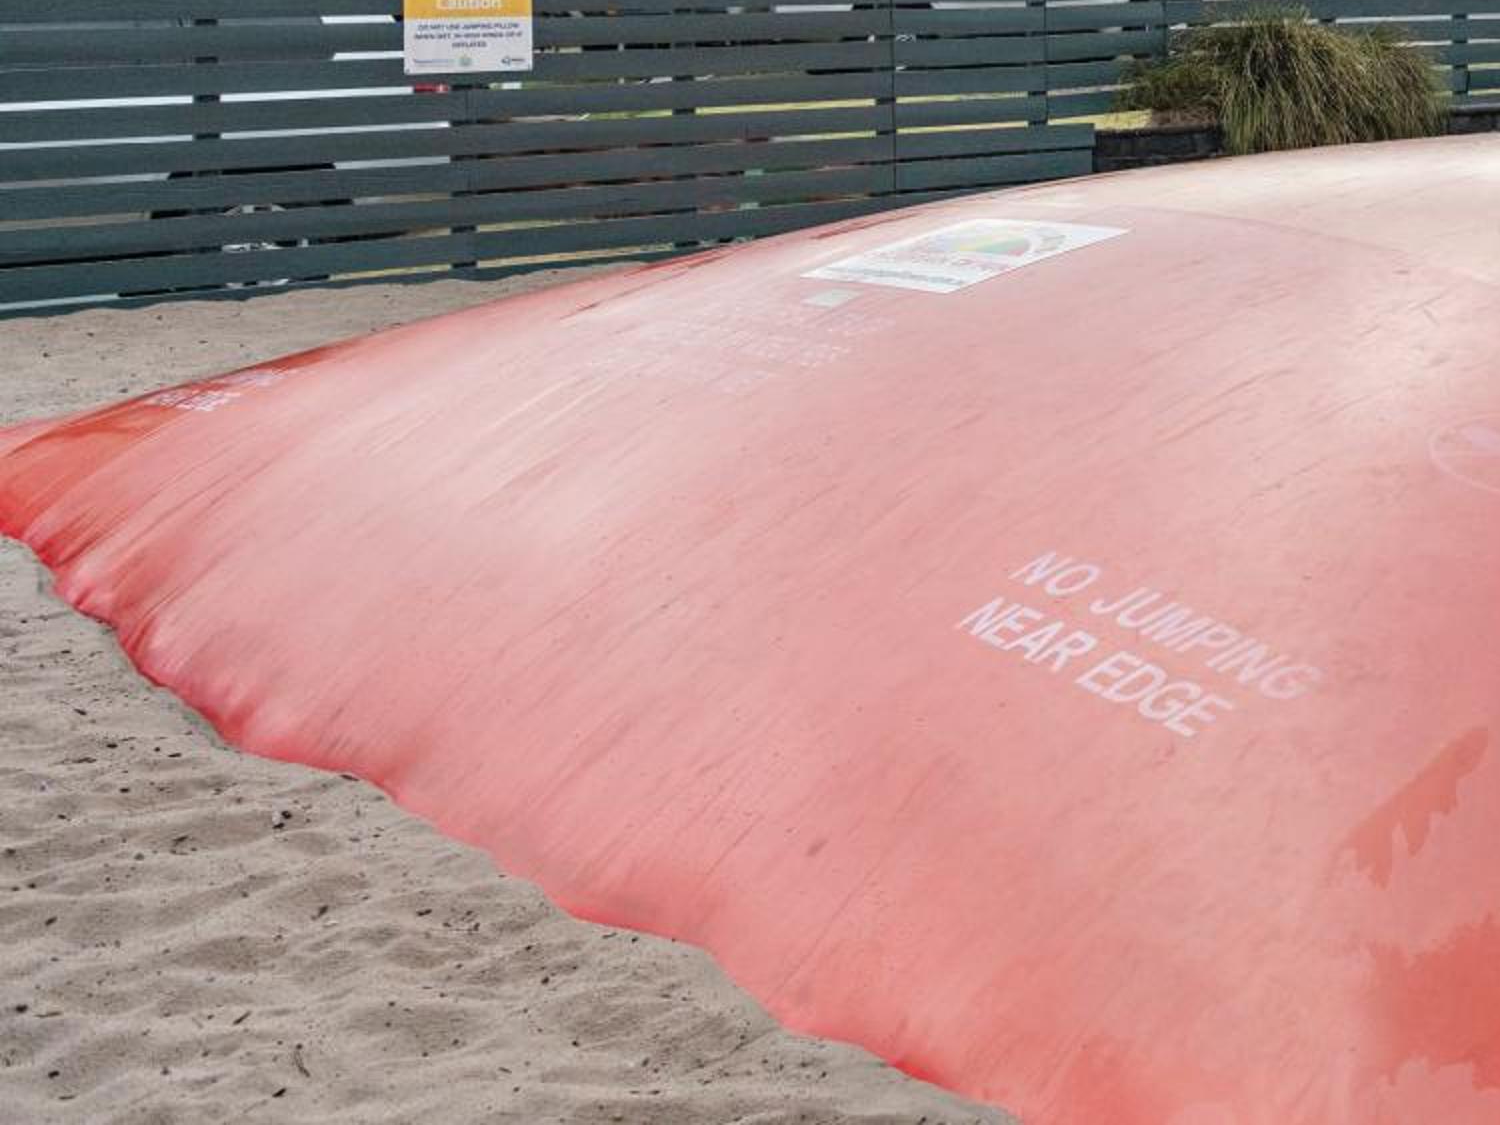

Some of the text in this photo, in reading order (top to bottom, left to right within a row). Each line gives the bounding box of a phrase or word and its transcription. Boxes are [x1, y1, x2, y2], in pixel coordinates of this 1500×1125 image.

[954, 596, 1236, 737] NEAR EDGE
[1008, 550, 1322, 700] NO JUMPING
